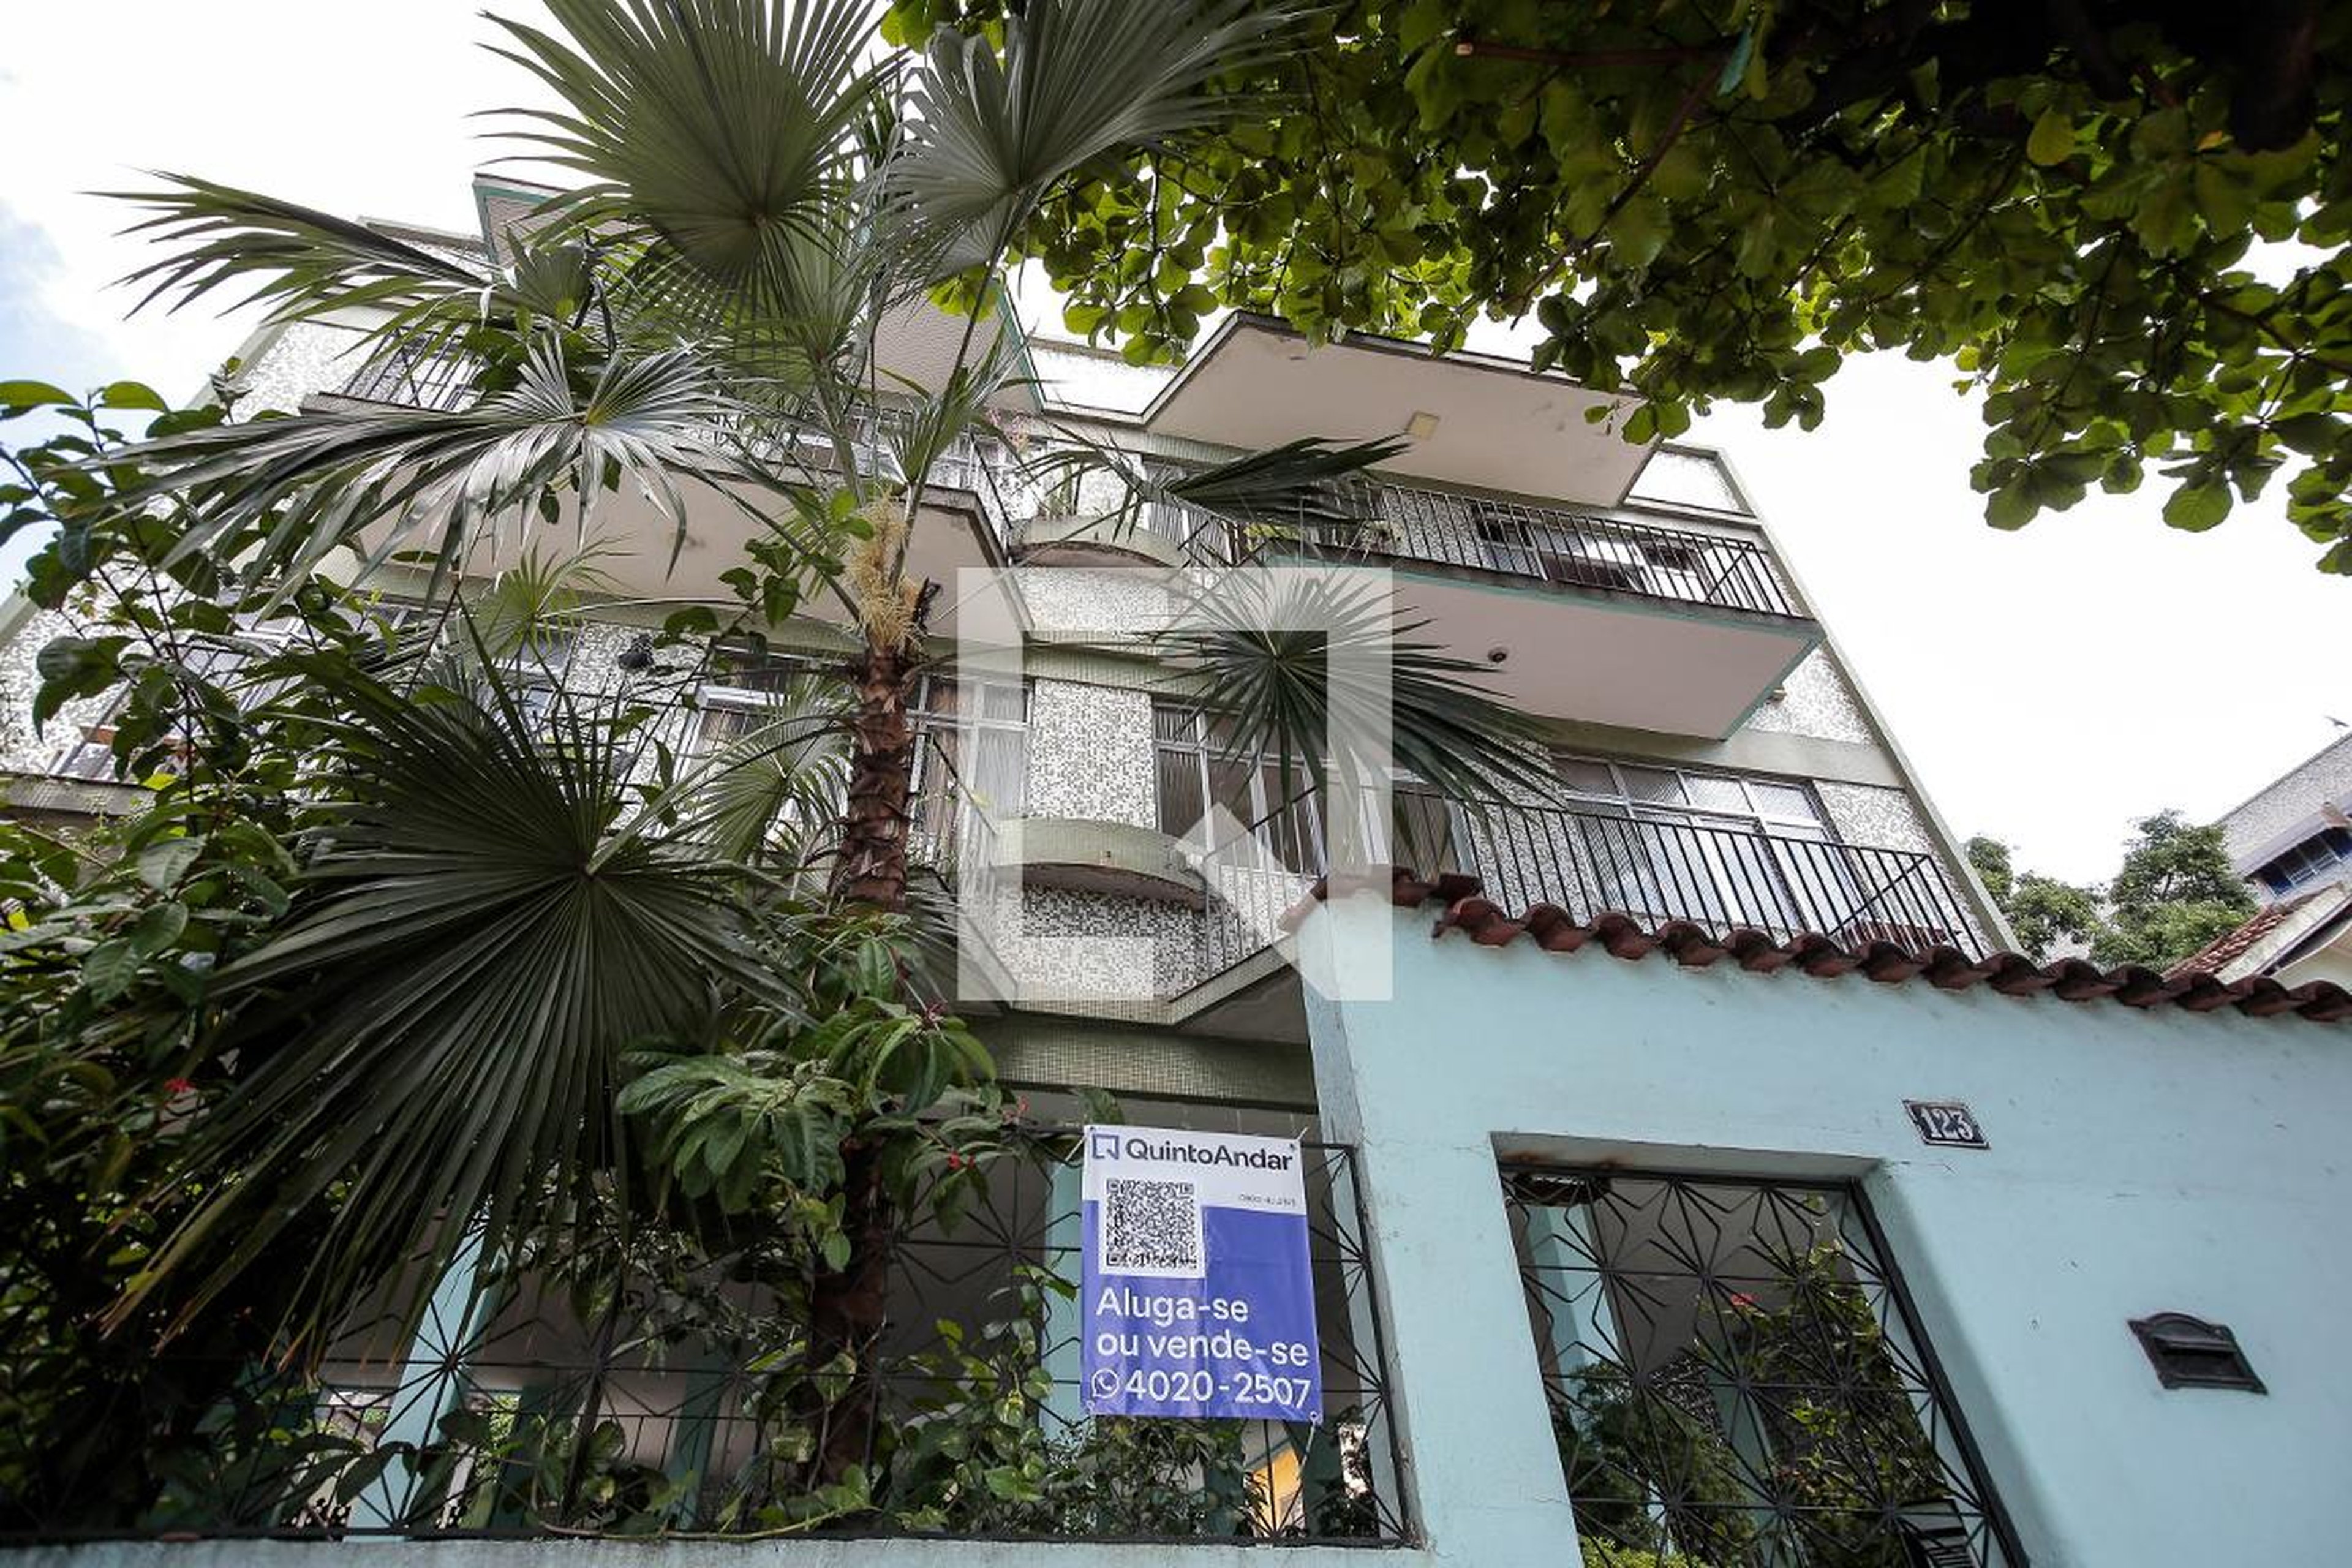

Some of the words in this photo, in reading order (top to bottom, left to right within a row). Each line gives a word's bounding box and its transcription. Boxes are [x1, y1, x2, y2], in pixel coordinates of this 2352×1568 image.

[1921, 1107, 1973, 1140] 123
[1126, 1138, 1293, 1170] QuintoAndar
[1096, 1287, 1249, 1327] Aluga-se
[1097, 1334, 1137, 1356] ou
[1148, 1329, 1310, 1367] vende-se
